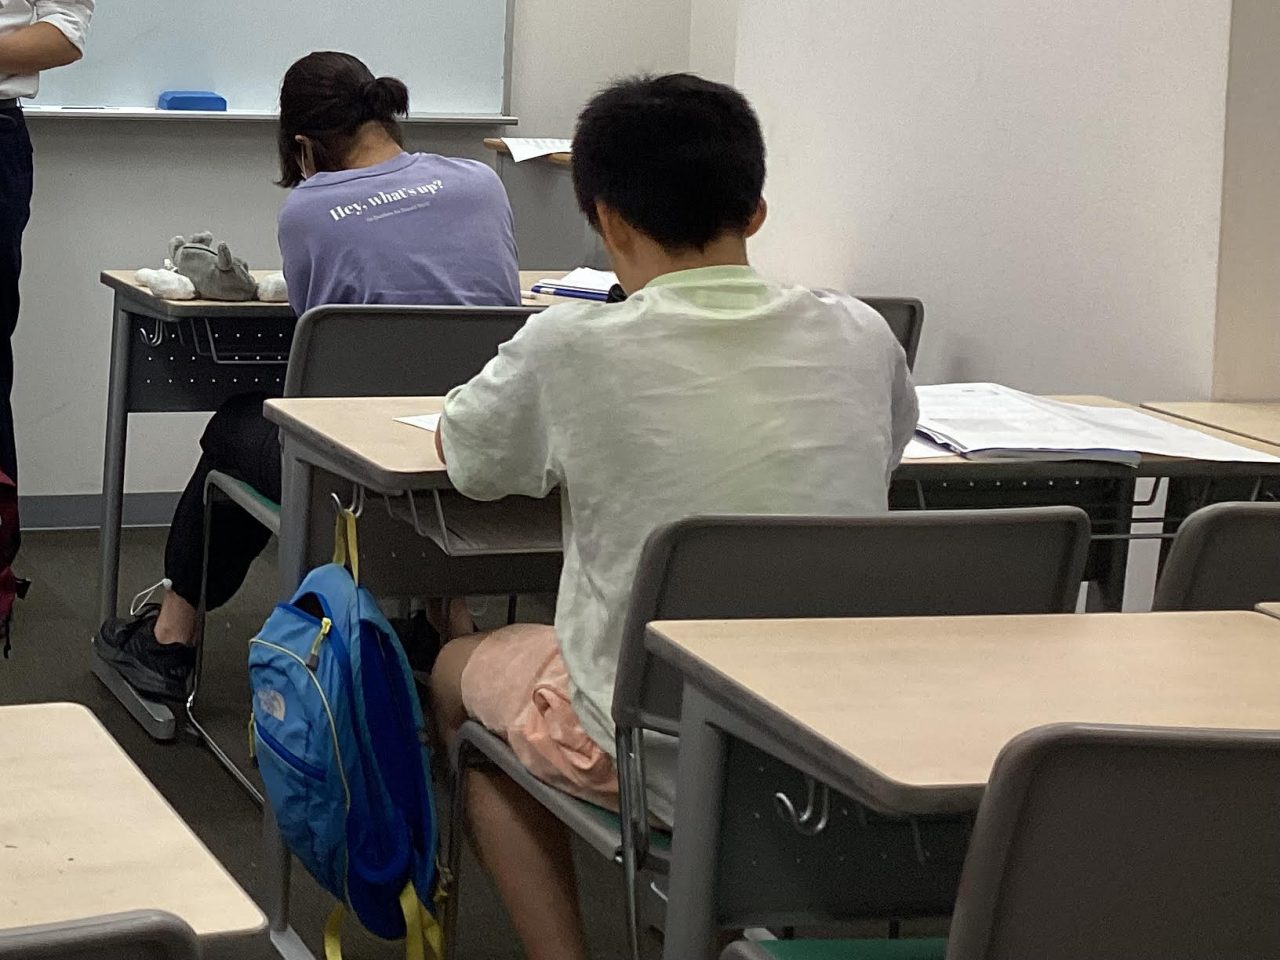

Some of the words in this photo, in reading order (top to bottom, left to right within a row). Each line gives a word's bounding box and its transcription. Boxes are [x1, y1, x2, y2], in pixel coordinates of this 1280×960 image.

[329, 204, 368, 221] Hey,
[367, 187, 417, 207] what's
[416, 179, 444, 195] up?
